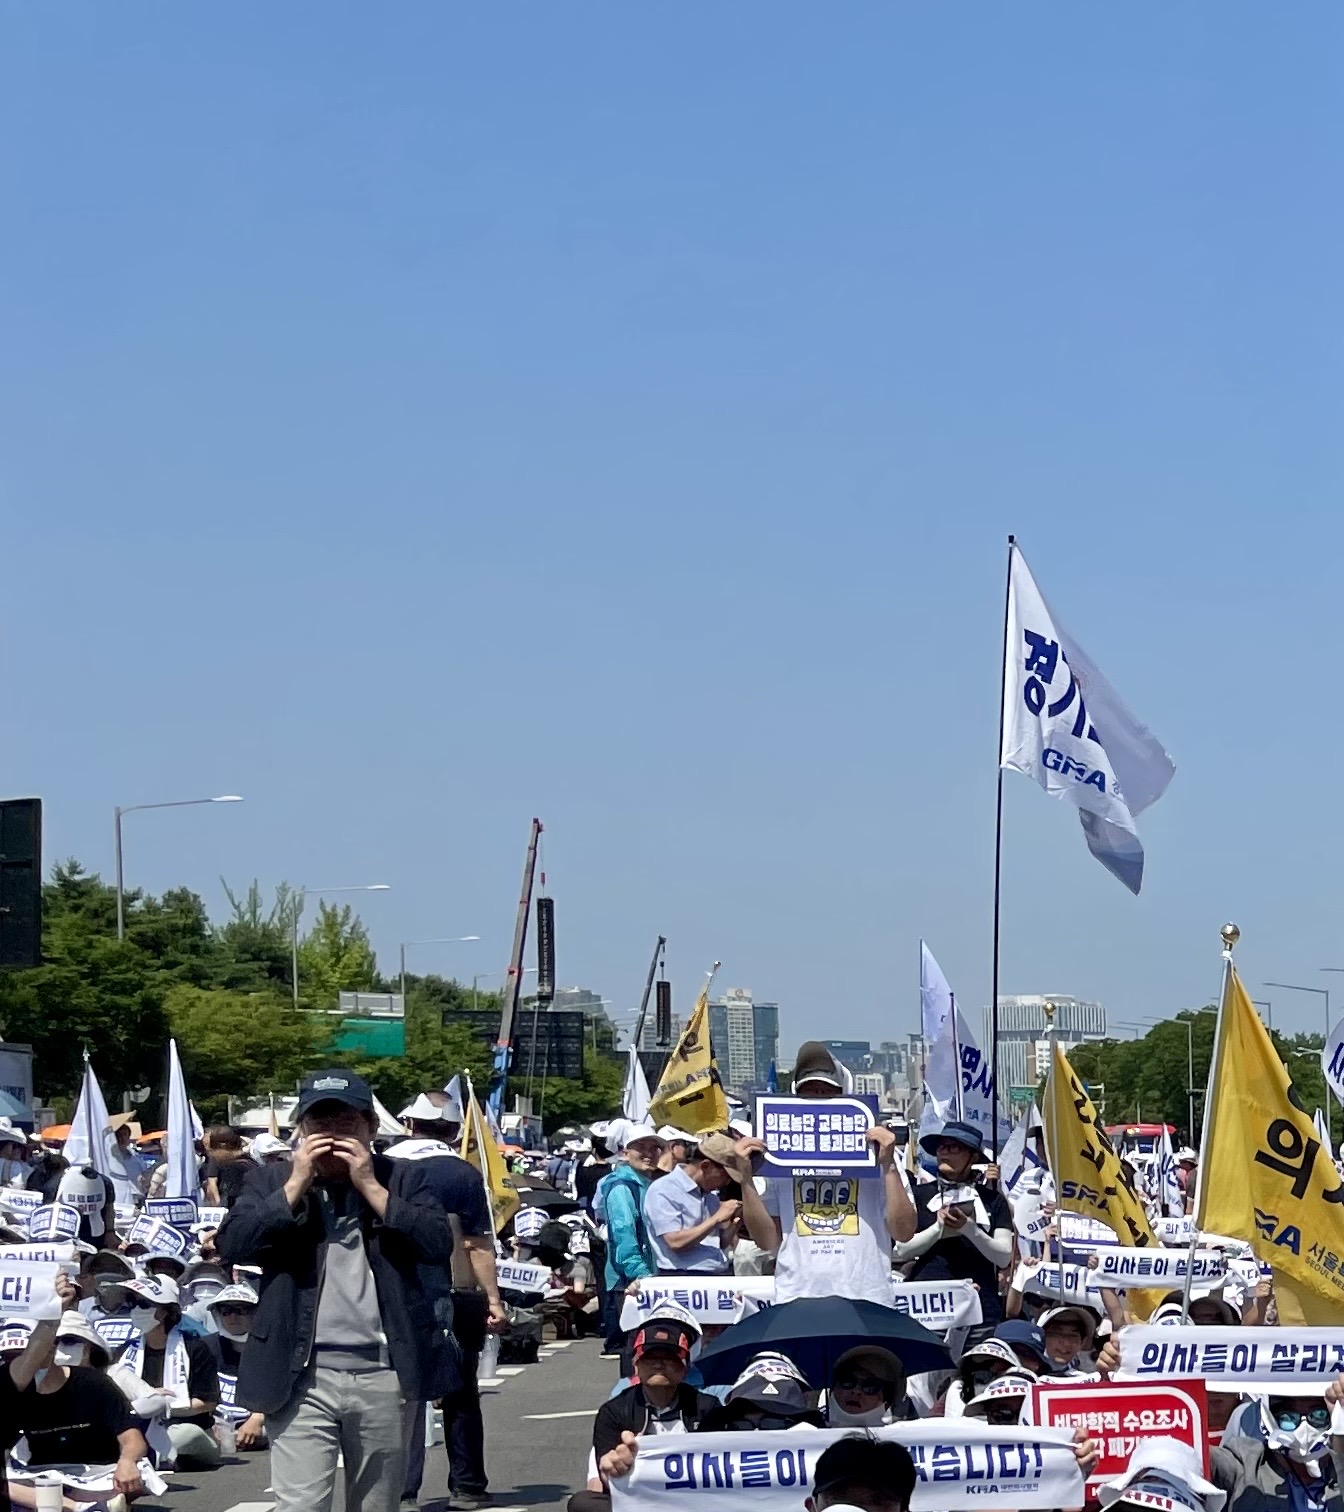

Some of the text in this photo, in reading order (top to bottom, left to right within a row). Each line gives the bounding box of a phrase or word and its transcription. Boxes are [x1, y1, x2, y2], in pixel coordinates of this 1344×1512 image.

[1042, 748, 1106, 793] GMA
[766, 1113, 867, 1133] 의료농단 교육농단
[766, 1133, 867, 1152] 필수의료 붕괴된다
[1104, 1256, 1169, 1277] 의사들이
[1137, 1342, 1258, 1374] 의사들이
[1123, 1409, 1189, 1432] 수요조사
[664, 1443, 1044, 1490] 의사들이 습니다!
